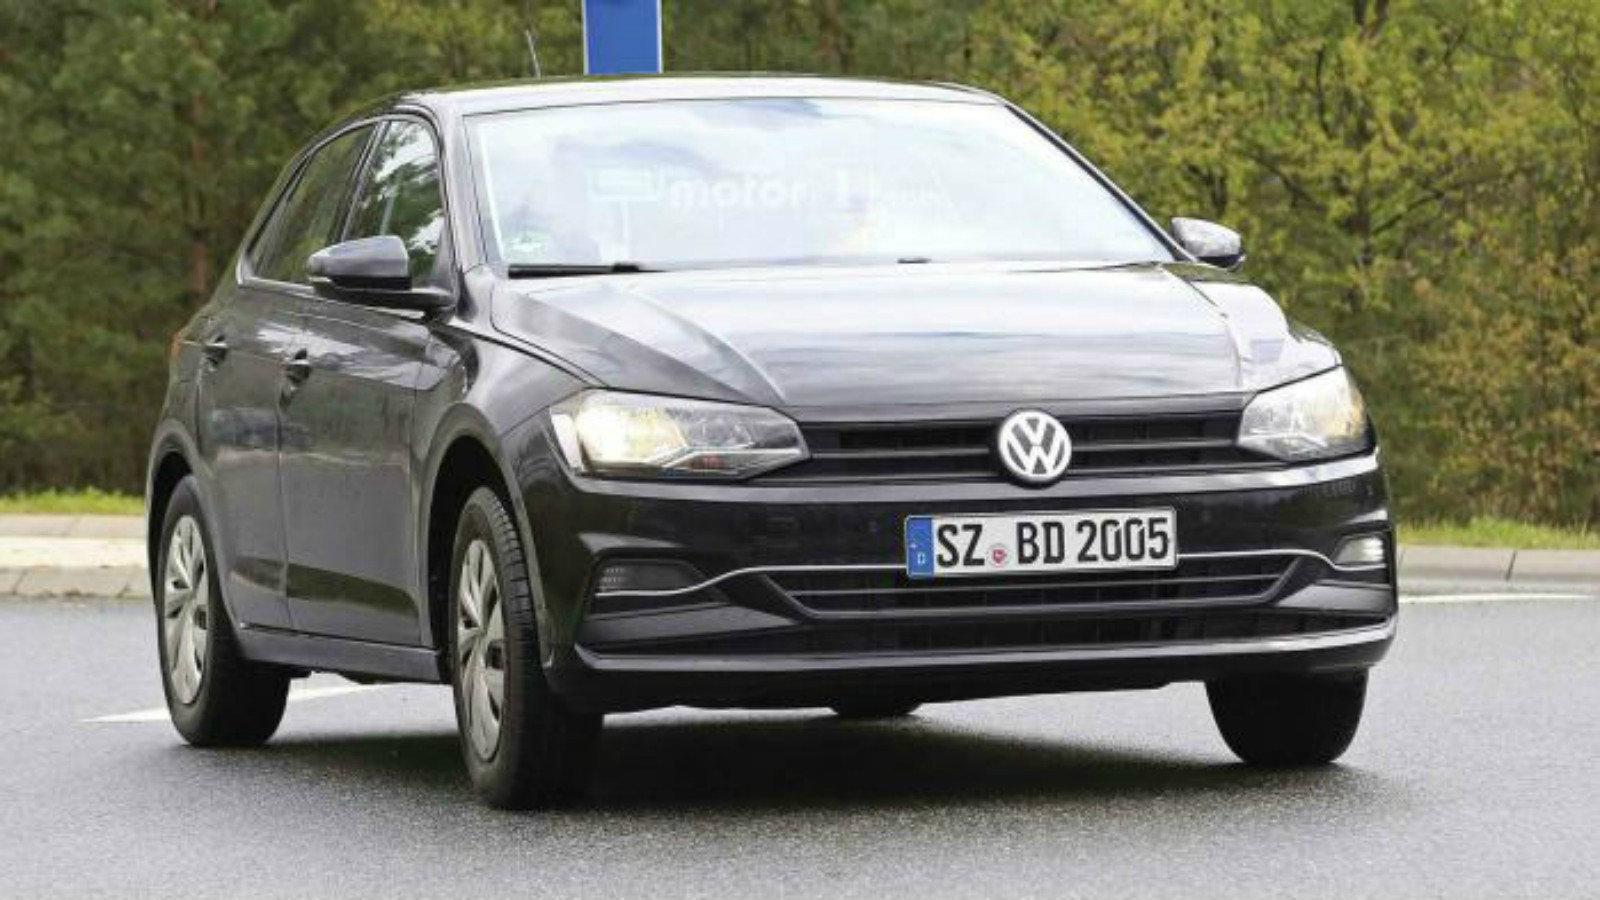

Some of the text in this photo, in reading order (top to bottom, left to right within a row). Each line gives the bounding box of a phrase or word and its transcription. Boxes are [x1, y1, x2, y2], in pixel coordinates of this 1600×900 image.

[1000, 410, 1072, 482] VW
[936, 517, 1168, 567] SZ BD 2005
